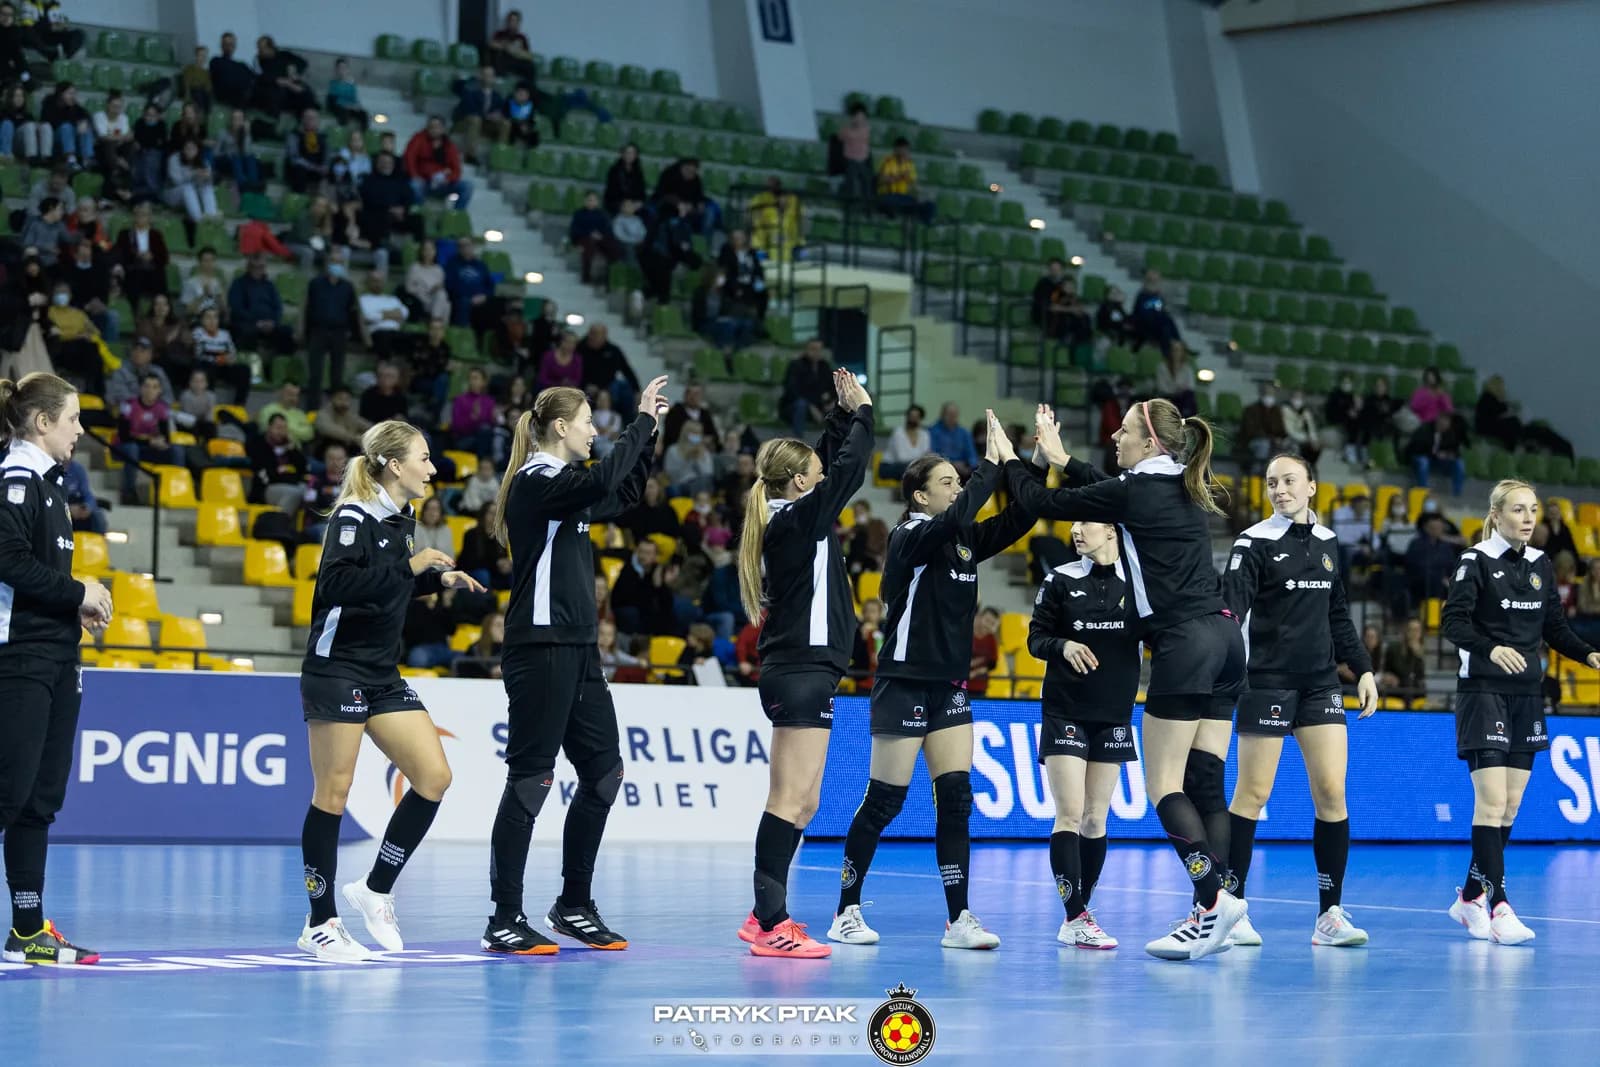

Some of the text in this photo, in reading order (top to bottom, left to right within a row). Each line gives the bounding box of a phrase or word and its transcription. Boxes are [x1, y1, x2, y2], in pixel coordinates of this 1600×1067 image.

[1297, 580, 1331, 589] SUZUKI
[1511, 601, 1542, 610] SUZUKI
[1085, 620, 1125, 629] SUZUKI
[492, 721, 770, 765] SRLIGA
[1104, 741, 1133, 750] PROFIKA
[79, 729, 287, 786] PGNiG
[559, 780, 719, 809] KBIET
